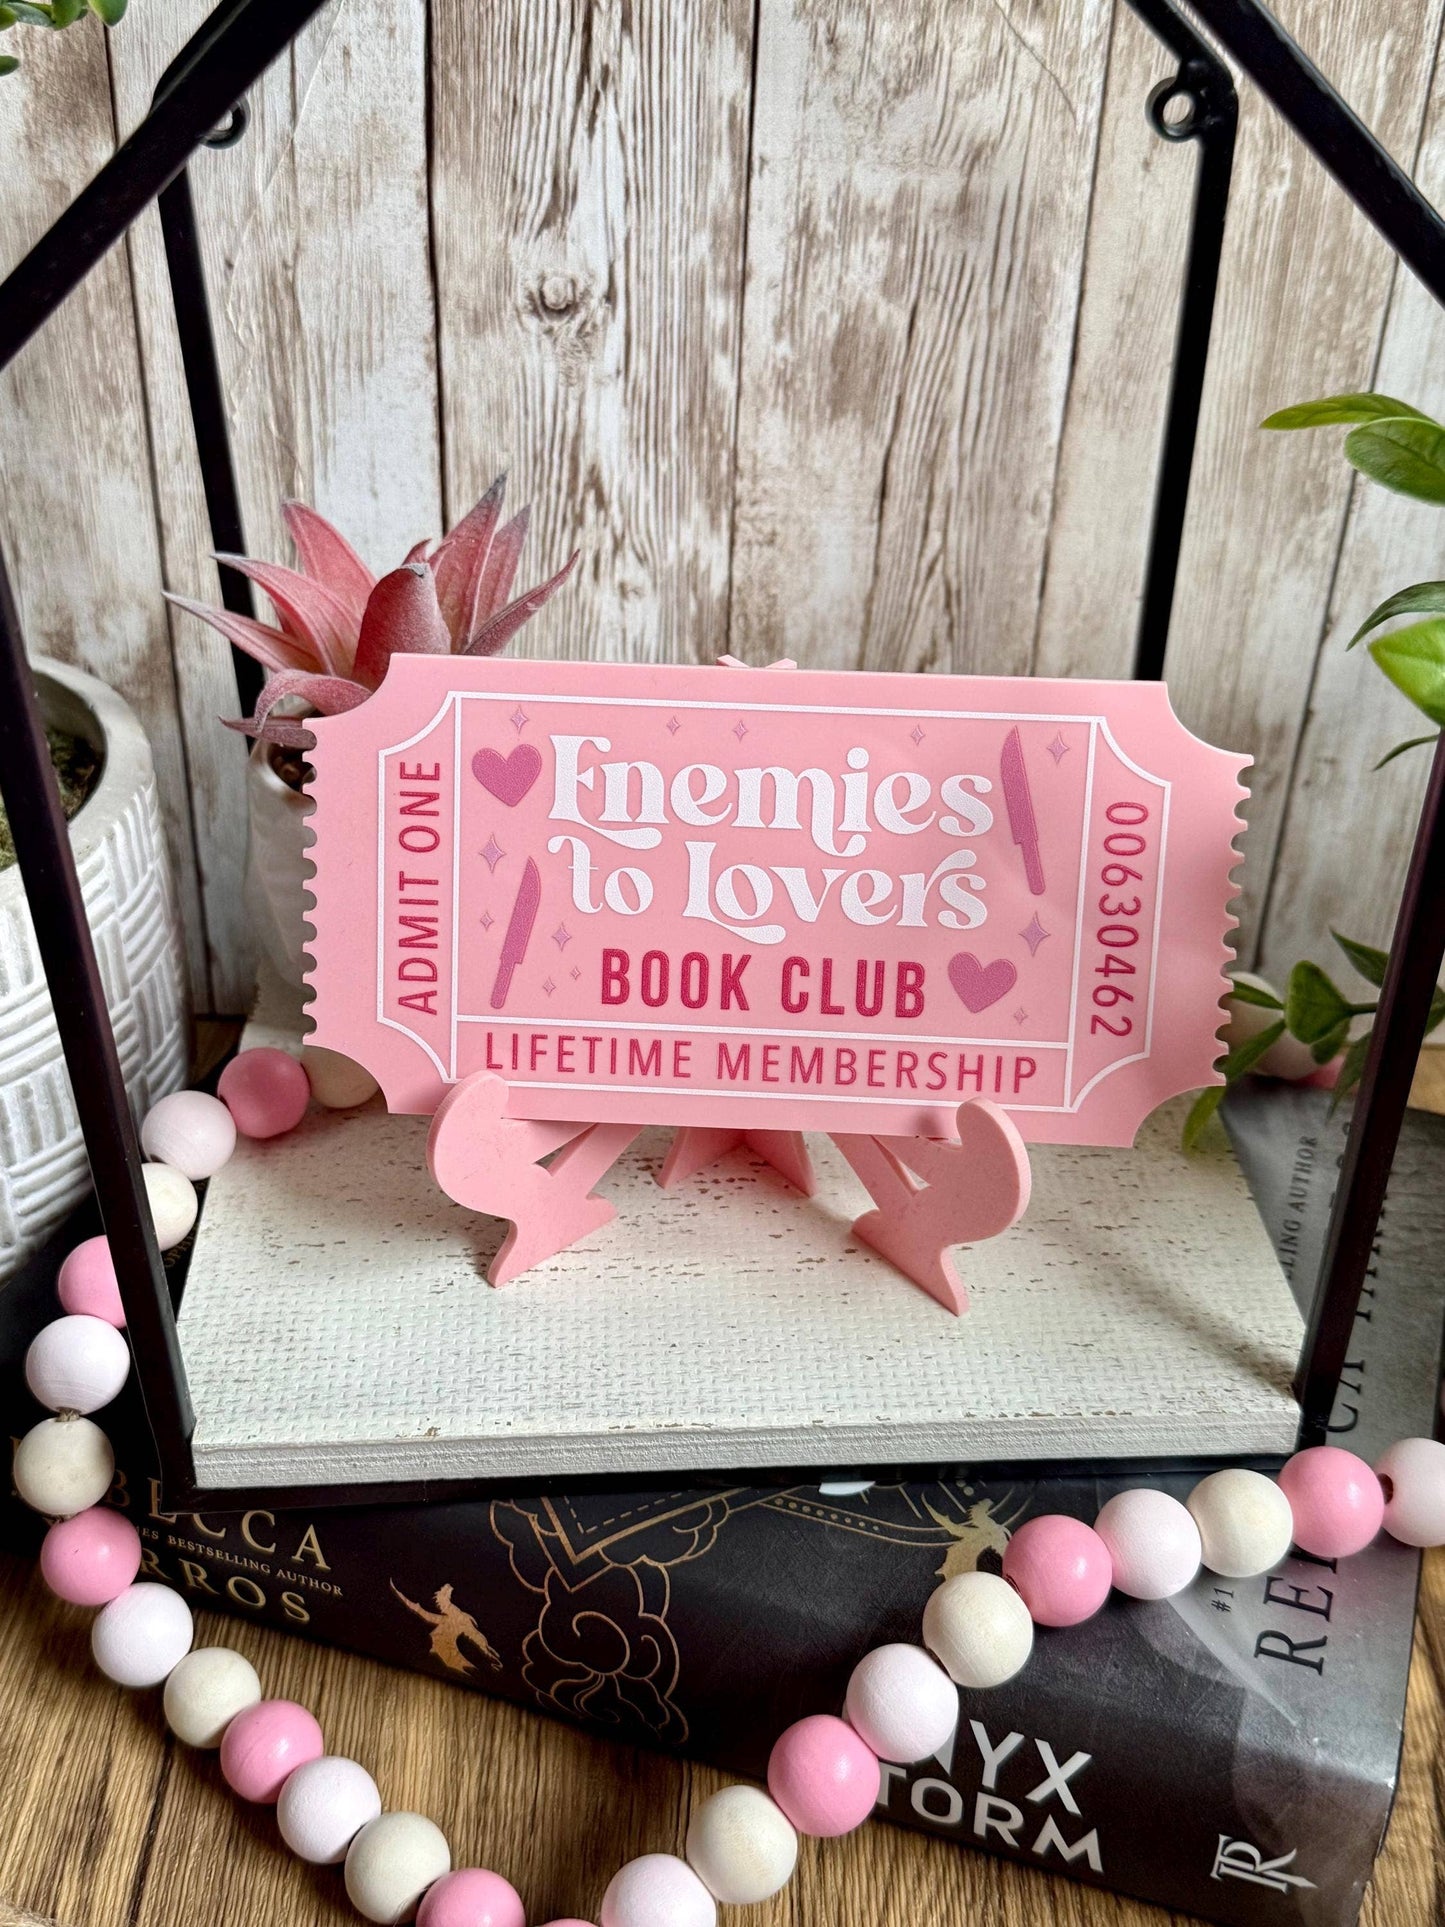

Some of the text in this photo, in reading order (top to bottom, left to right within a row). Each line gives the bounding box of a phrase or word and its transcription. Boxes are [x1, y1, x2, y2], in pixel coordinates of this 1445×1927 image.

[548, 735, 994, 857] Enemies
[398, 761, 440, 1016] ADMIT ONE
[547, 835, 988, 945] to Lovers
[1090, 801, 1149, 1037] 00630462
[601, 948, 926, 1018] BOOK CLUB
[485, 1032, 1038, 1093] LIFETIME MEMBERSHIP
[1288, 1136, 1318, 1213] AUTHOR
[167, 1534, 272, 1574] BESTSELLING
[275, 1568, 345, 1597] AUTHOR
[1211, 1586, 1235, 1613] #1
